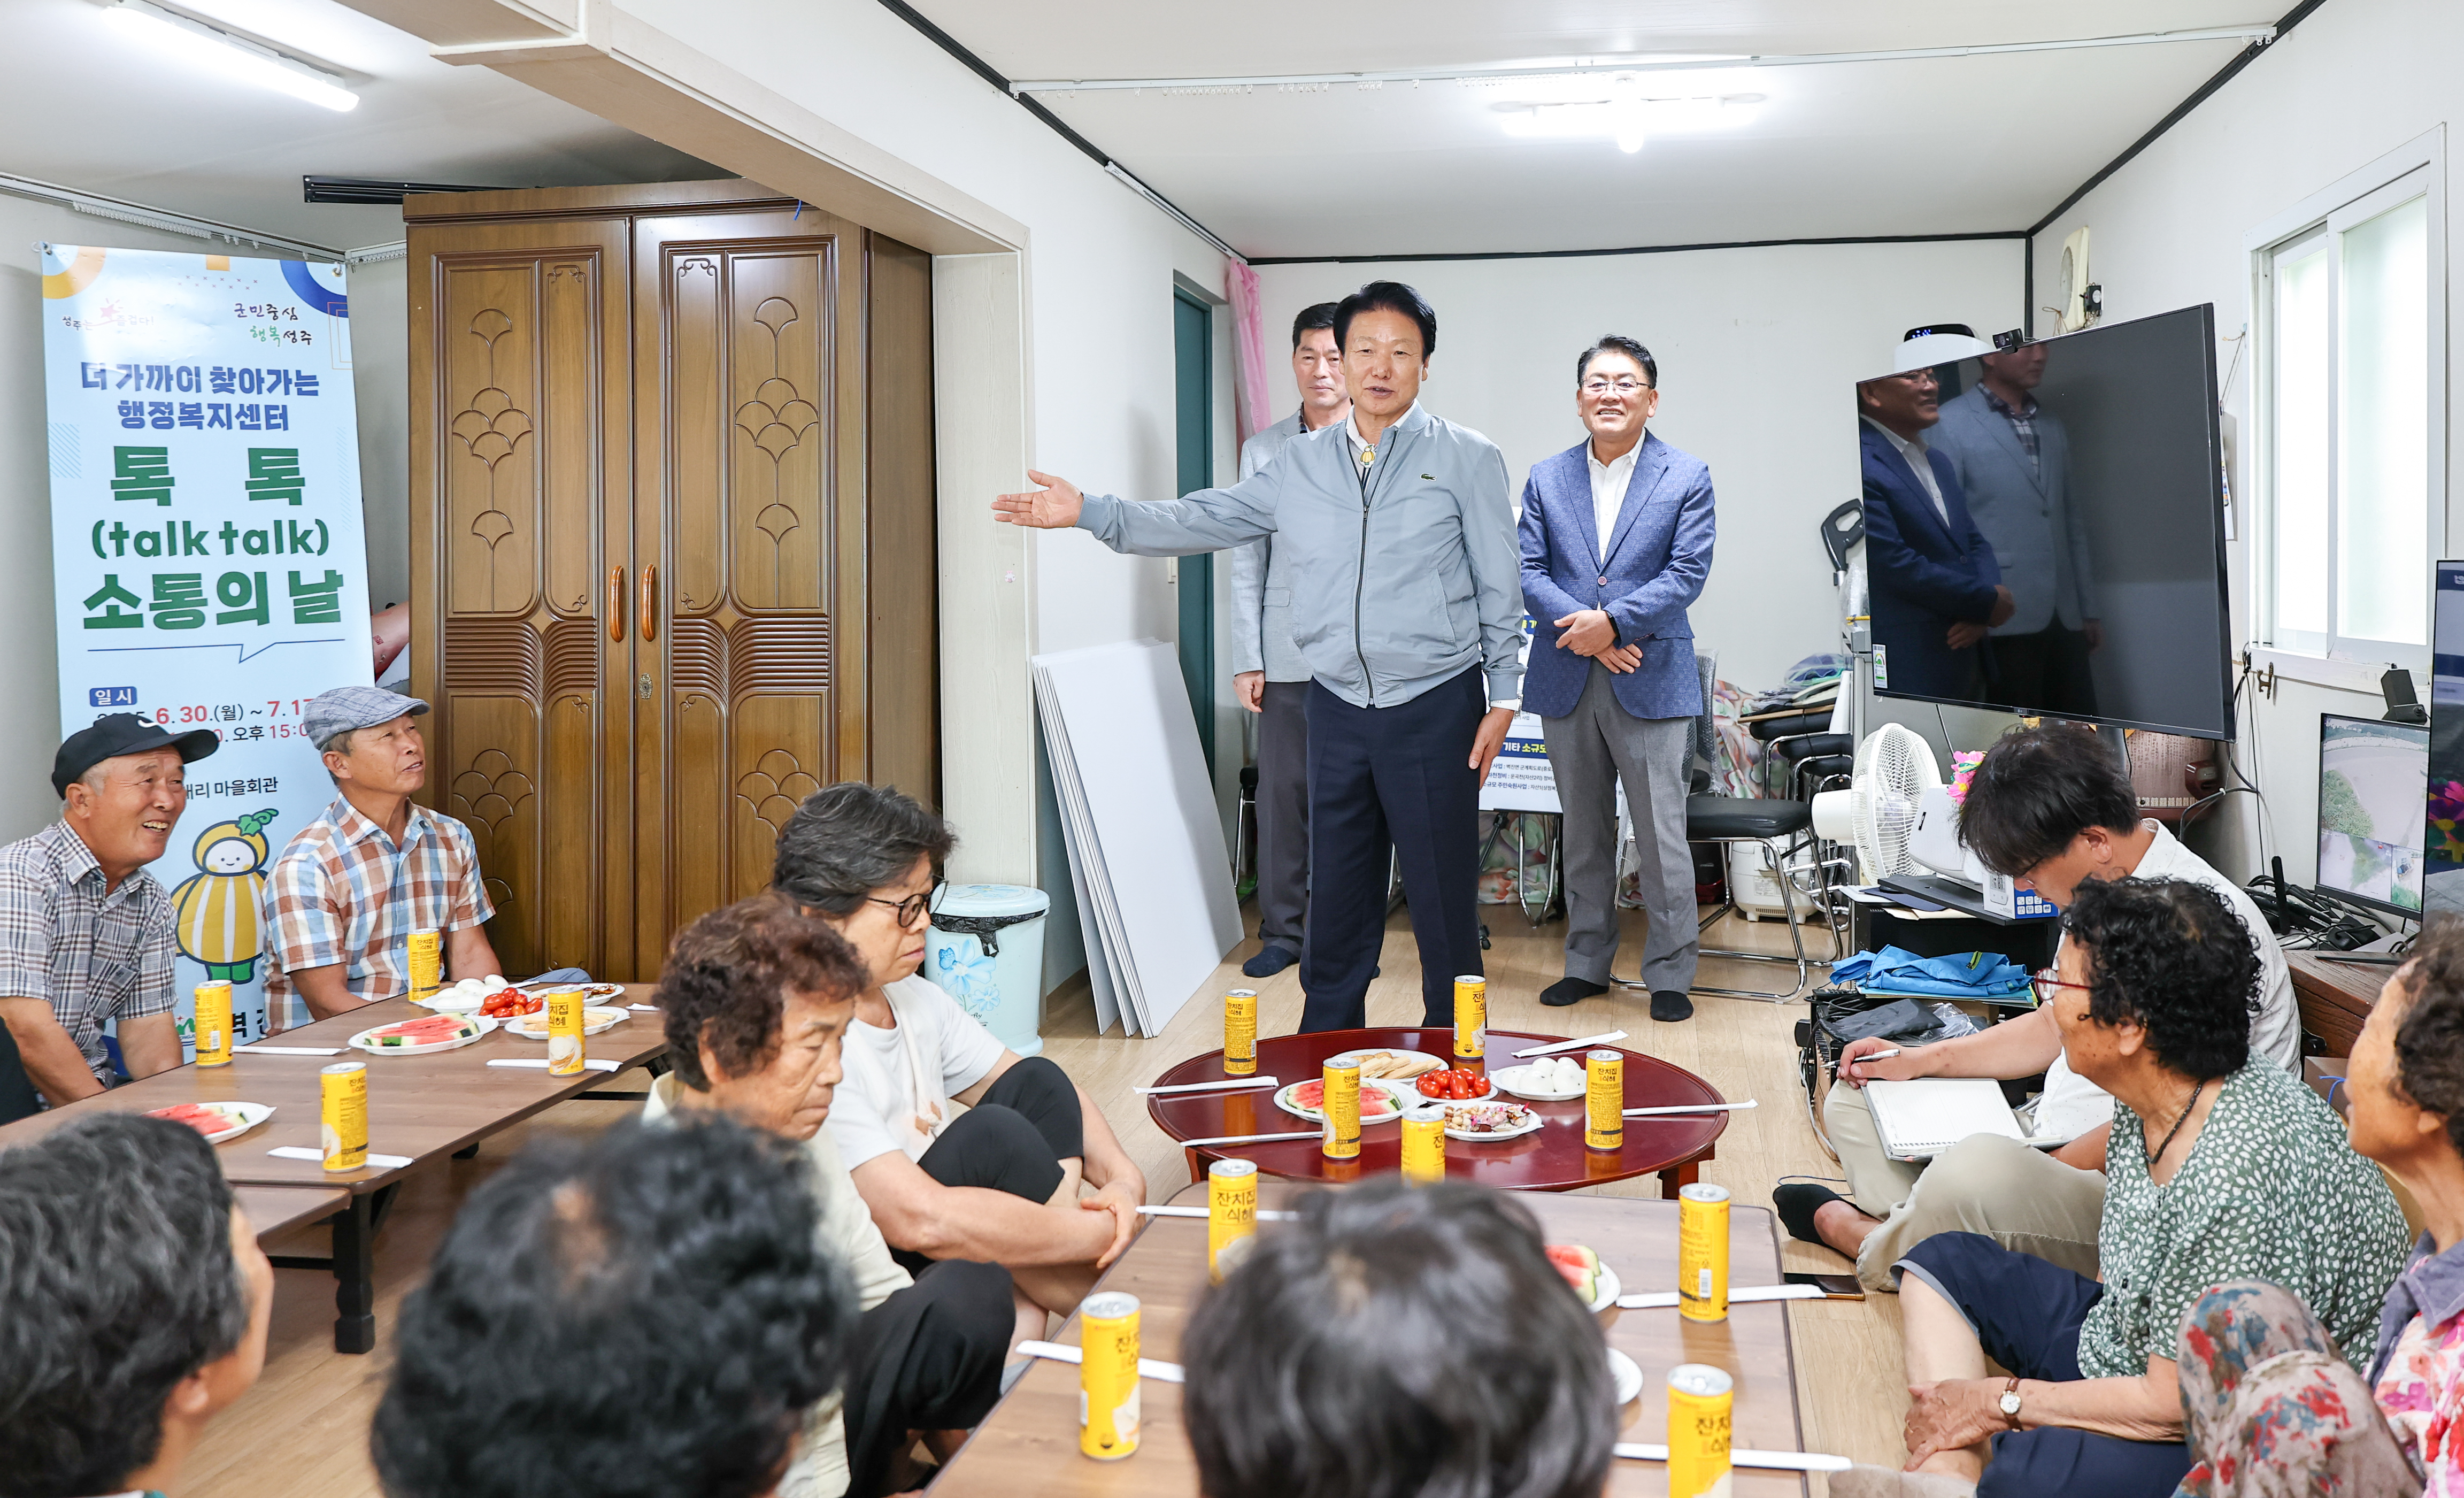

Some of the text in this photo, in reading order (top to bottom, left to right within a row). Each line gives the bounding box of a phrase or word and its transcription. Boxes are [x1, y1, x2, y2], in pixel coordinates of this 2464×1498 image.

[81, 362, 319, 396] 더 가까이 찾아가는
[118, 400, 289, 432] 행정복지센터
[110, 445, 306, 506] 톡 톡
[91, 518, 329, 559] (talk talk)
[82, 570, 344, 630] 소통의 날
[233, 725, 265, 741] 오후
[1503, 742, 1521, 752] 기타
[214, 776, 279, 797] 마을회관
[1216, 1189, 1256, 1207] 잔치집
